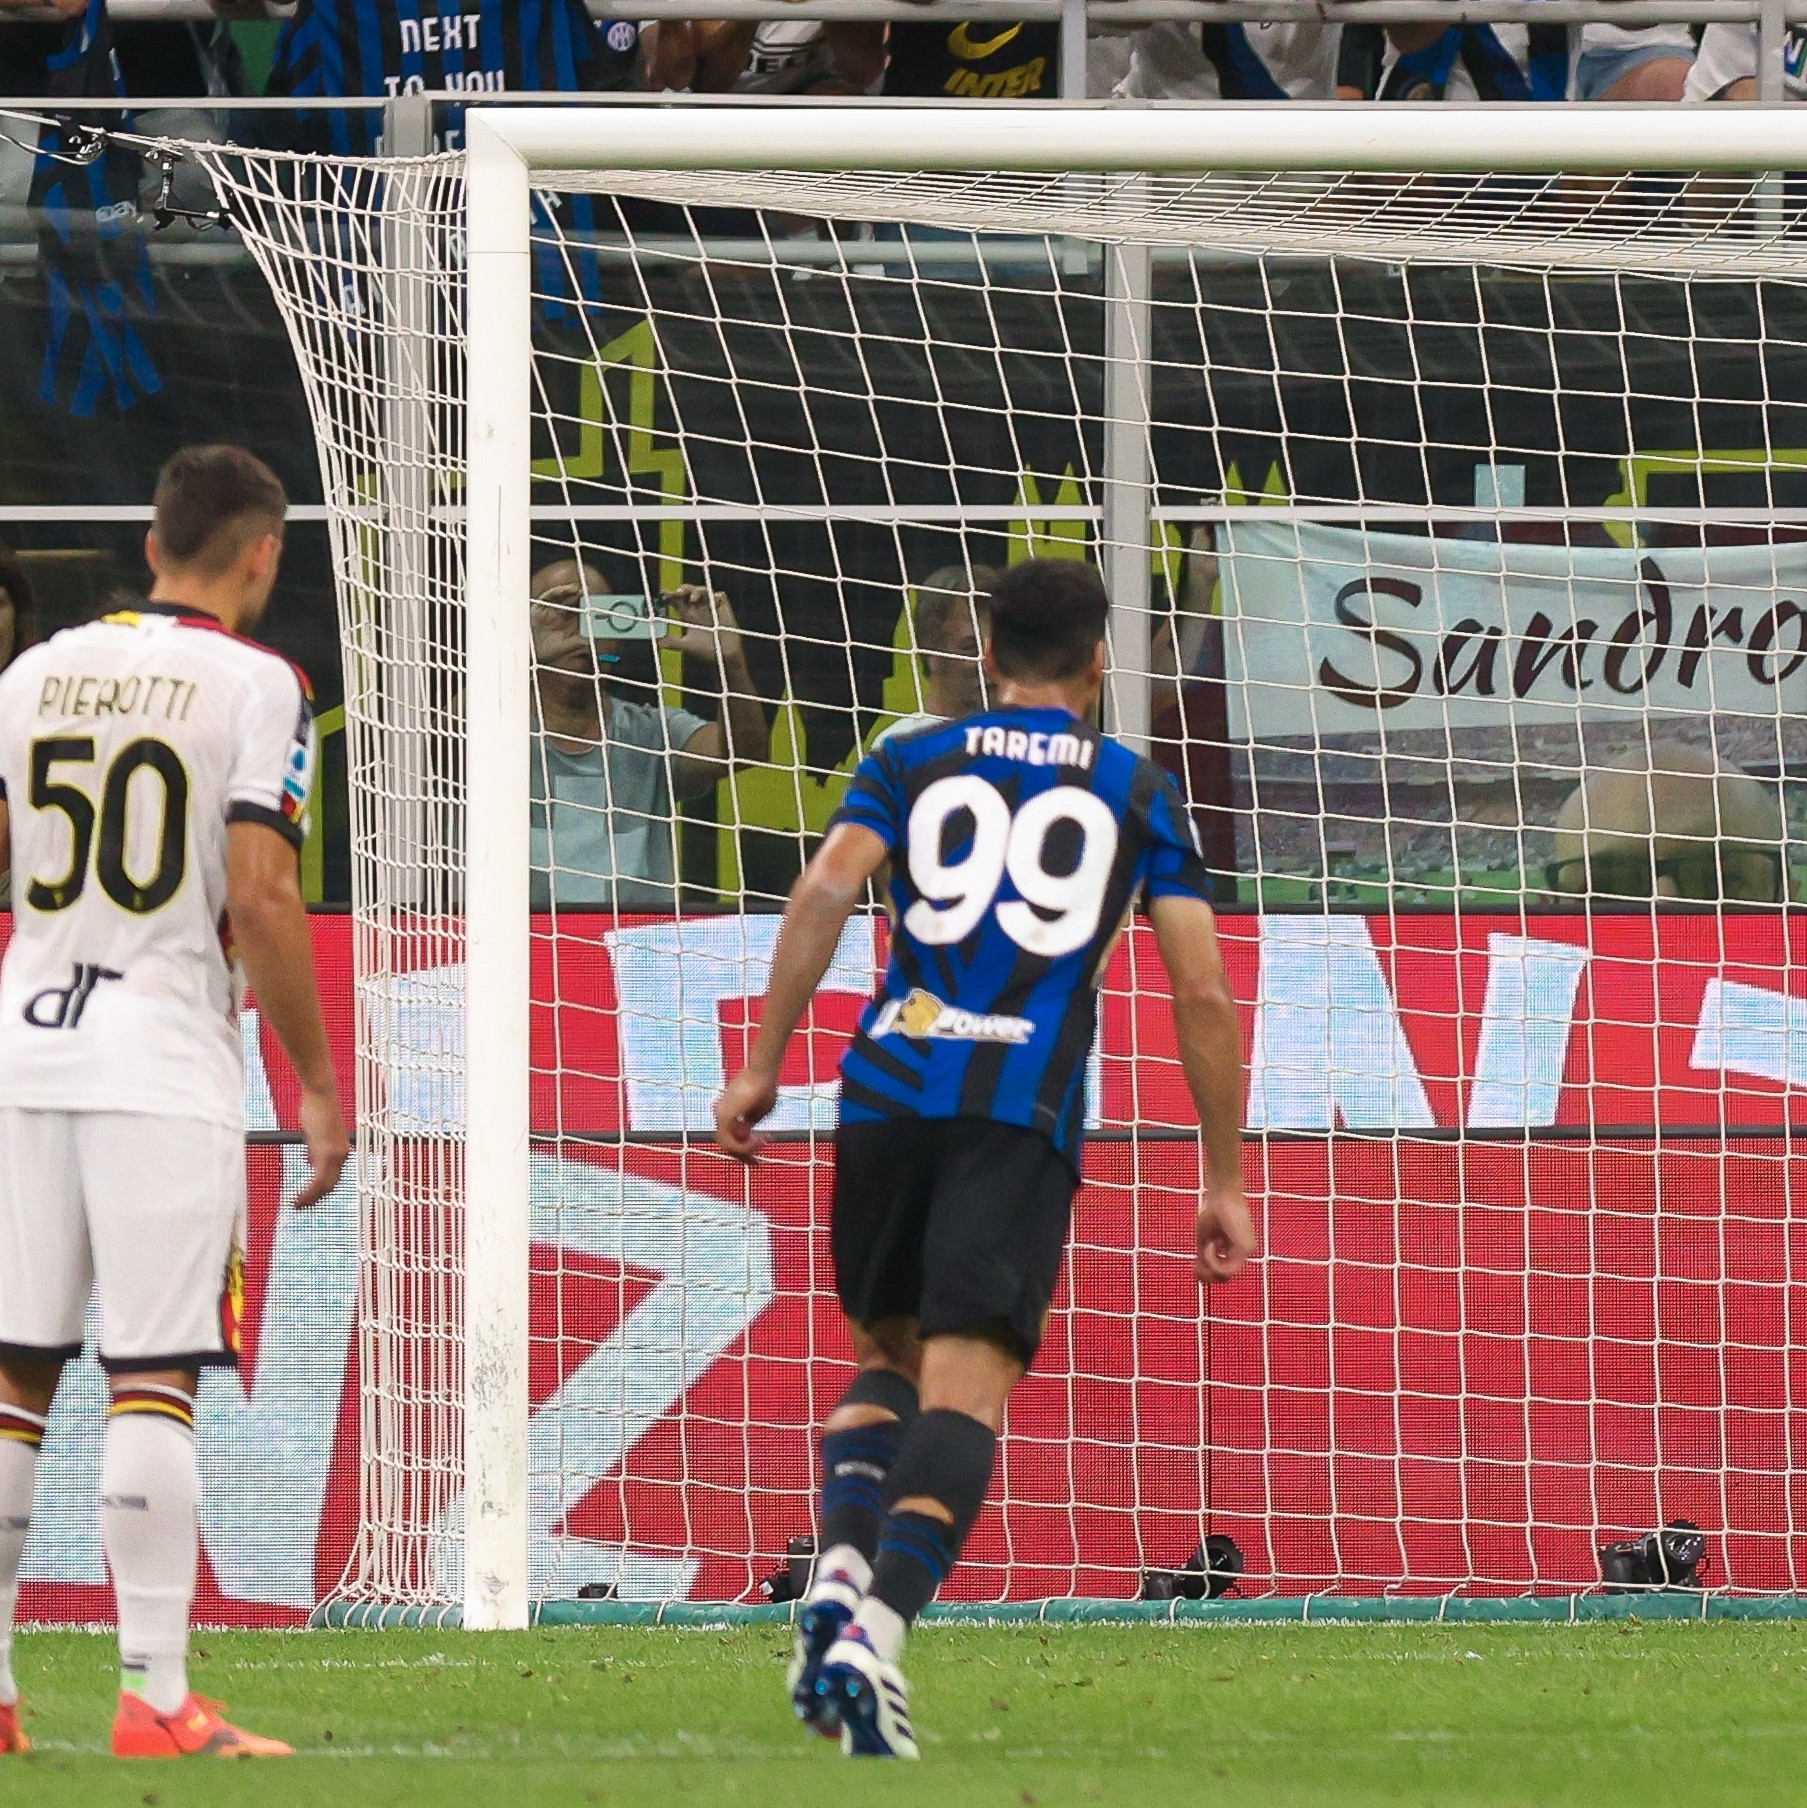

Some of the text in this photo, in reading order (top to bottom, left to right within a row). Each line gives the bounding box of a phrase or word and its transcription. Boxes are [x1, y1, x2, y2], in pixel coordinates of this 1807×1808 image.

[399, 13, 482, 54] NEXT
[944, 57, 1047, 98] INTER
[37, 674, 198, 724] PIEROTTI
[963, 723, 1094, 772] TAREMI
[26, 734, 191, 914] 50
[902, 773, 1120, 958] 99
